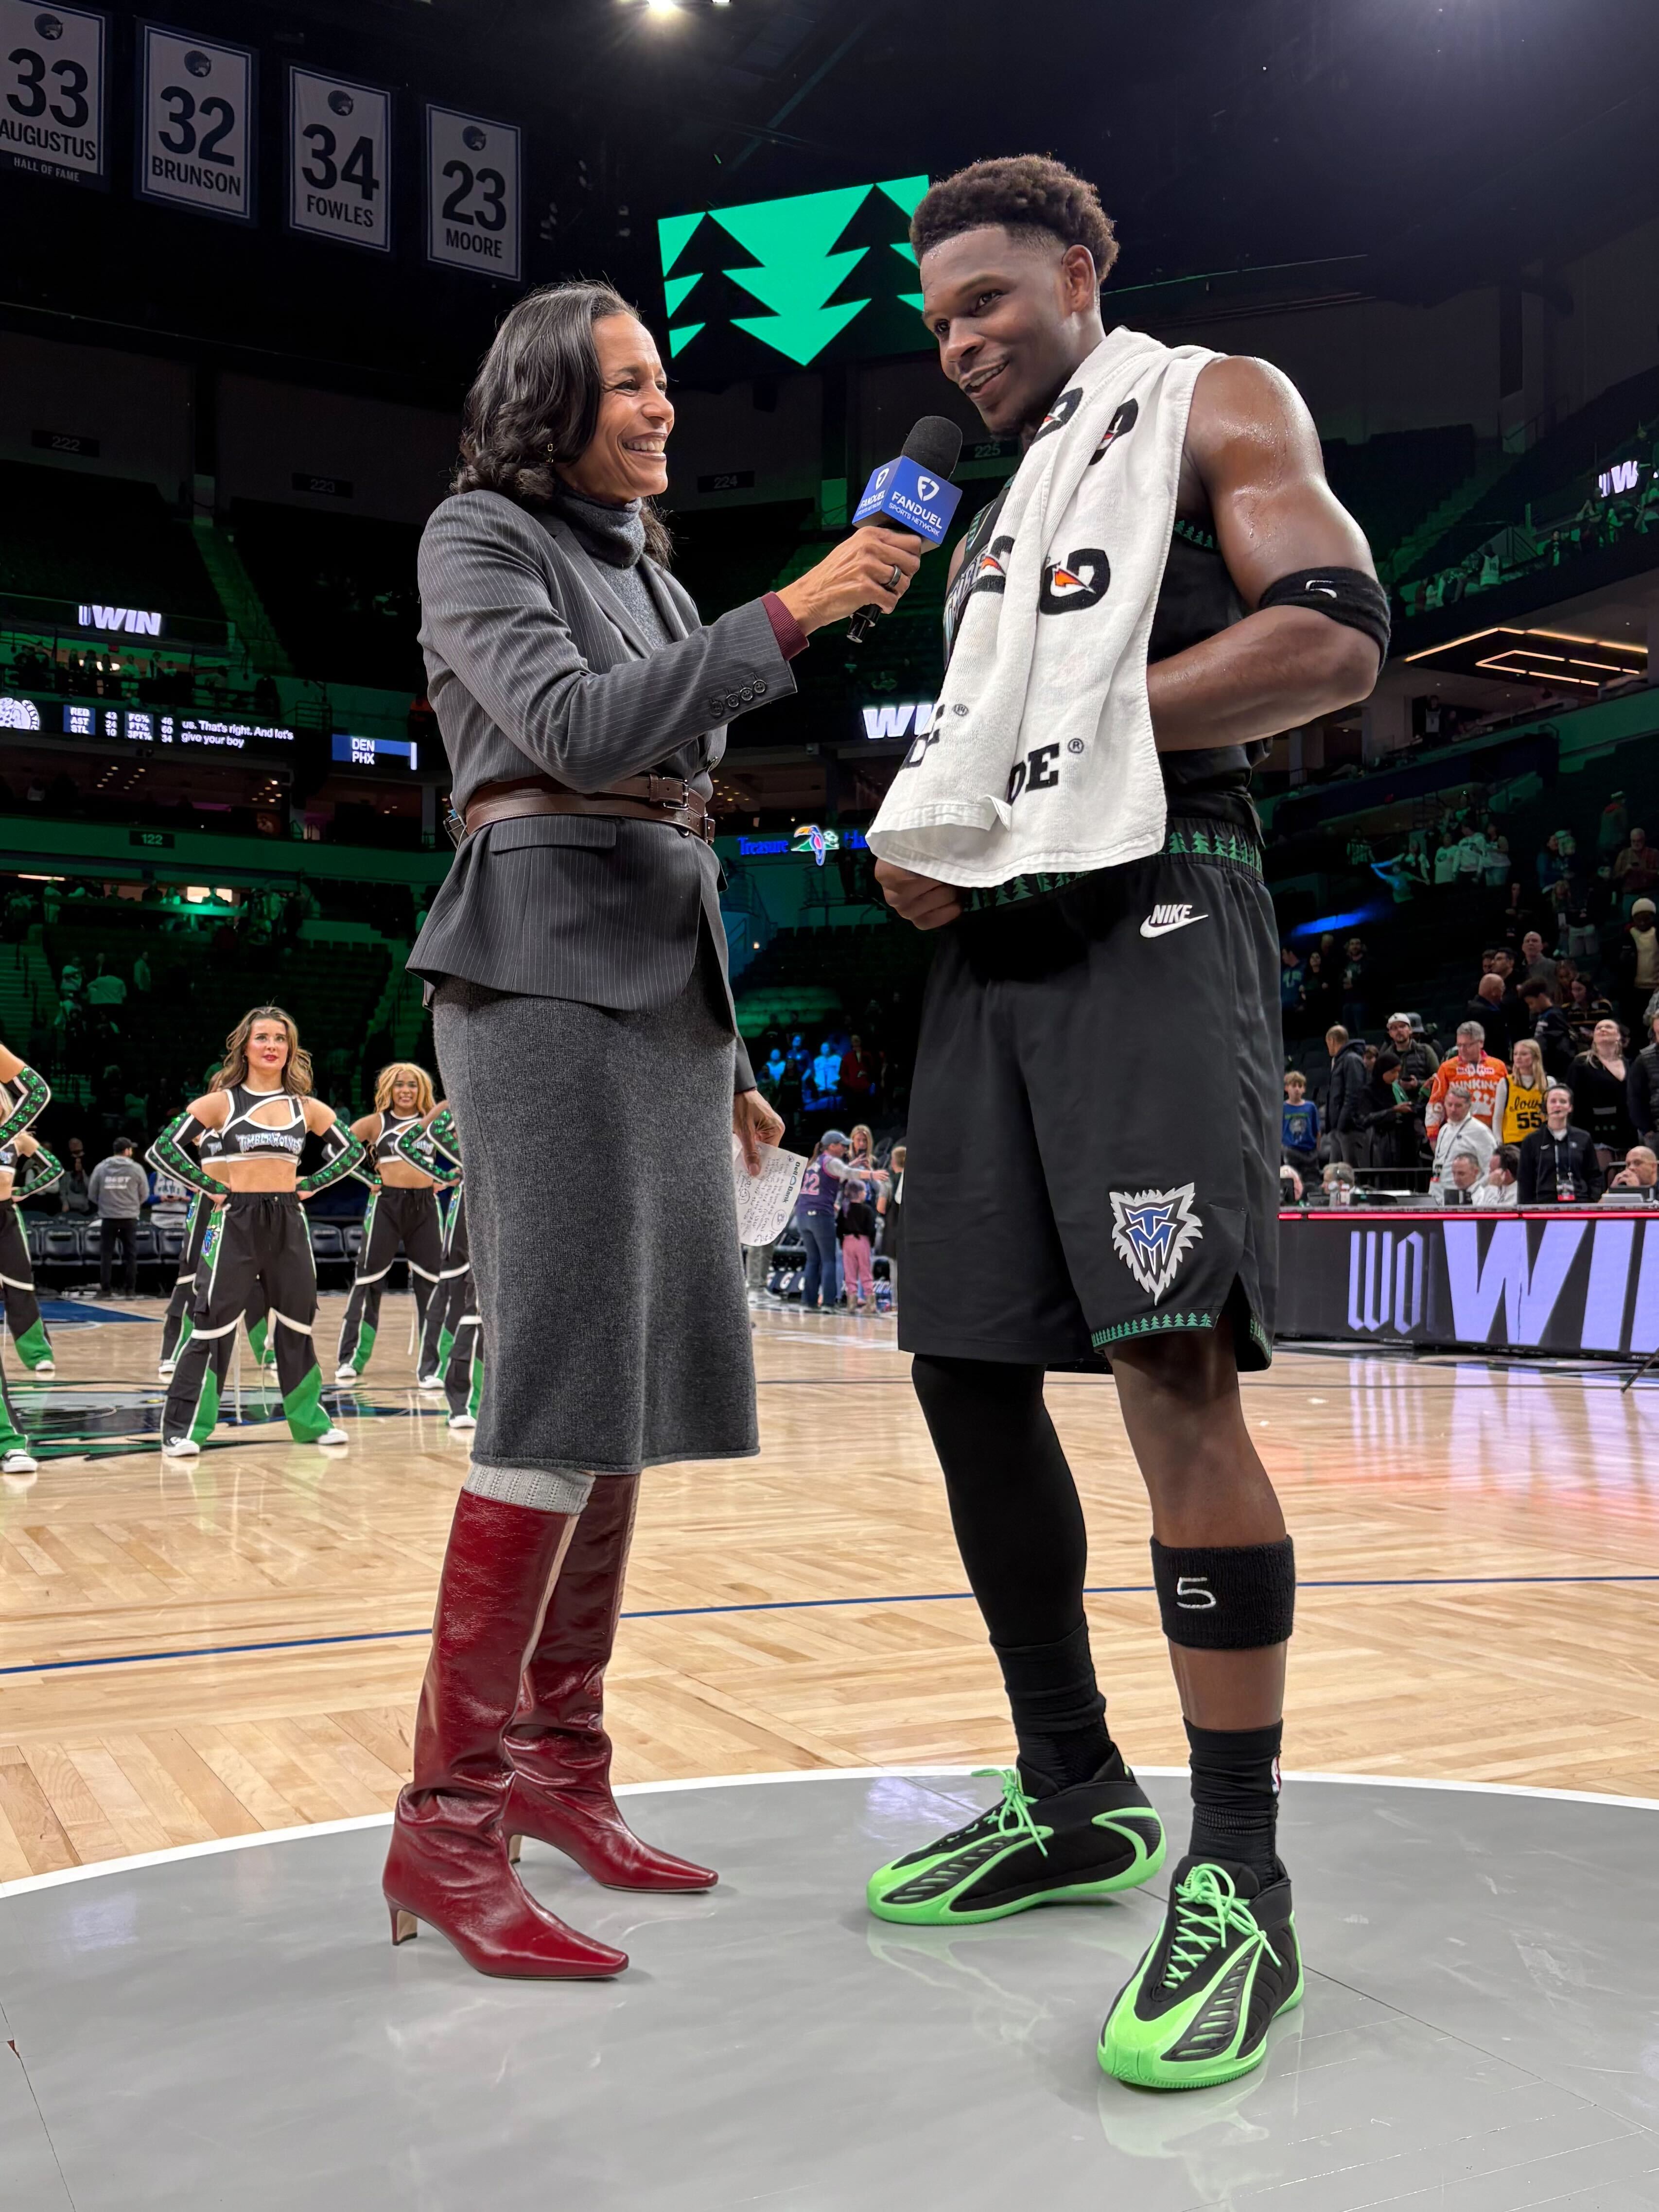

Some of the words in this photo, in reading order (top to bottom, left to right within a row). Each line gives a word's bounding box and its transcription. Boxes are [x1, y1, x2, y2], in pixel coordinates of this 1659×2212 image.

[6, 48, 89, 128] 33
[158, 86, 235, 166] 32
[0, 118, 96, 161] AUGUSTUS
[14, 157, 37, 172] HALL
[41, 164, 53, 174] OF
[55, 167, 80, 182] FAME
[302, 123, 379, 201] 34
[152, 156, 241, 196] BRUNSON
[441, 159, 506, 231] 23
[307, 194, 373, 227] FOWLES
[446, 227, 502, 258] MOORE
[52, 436, 80, 452] 222
[975, 443, 1000, 457] 225
[310, 478, 335, 493] 223
[714, 475, 737, 489] 224
[889, 502, 911, 519] SPORTS
[911, 515, 941, 536] NETWORK
[891, 491, 943, 529] FANDUEL
[92, 605, 161, 636] WIN
[198, 720, 227, 733] That's
[229, 724, 253, 736] right.
[254, 727, 273, 737] And
[863, 703, 937, 739] WI
[181, 732, 202, 743] give
[203, 734, 225, 745] your
[227, 736, 245, 748] boy
[352, 738, 375, 752] DEN
[352, 751, 375, 765] PHX
[141, 833, 163, 846] 122
[737, 836, 788, 856] Treasure
[1150, 904, 1192, 924] NIKE
[1509, 1096, 1542, 1112] Iow
[1517, 1112, 1542, 1129] 55
[1176, 1577, 1216, 1609] 5
